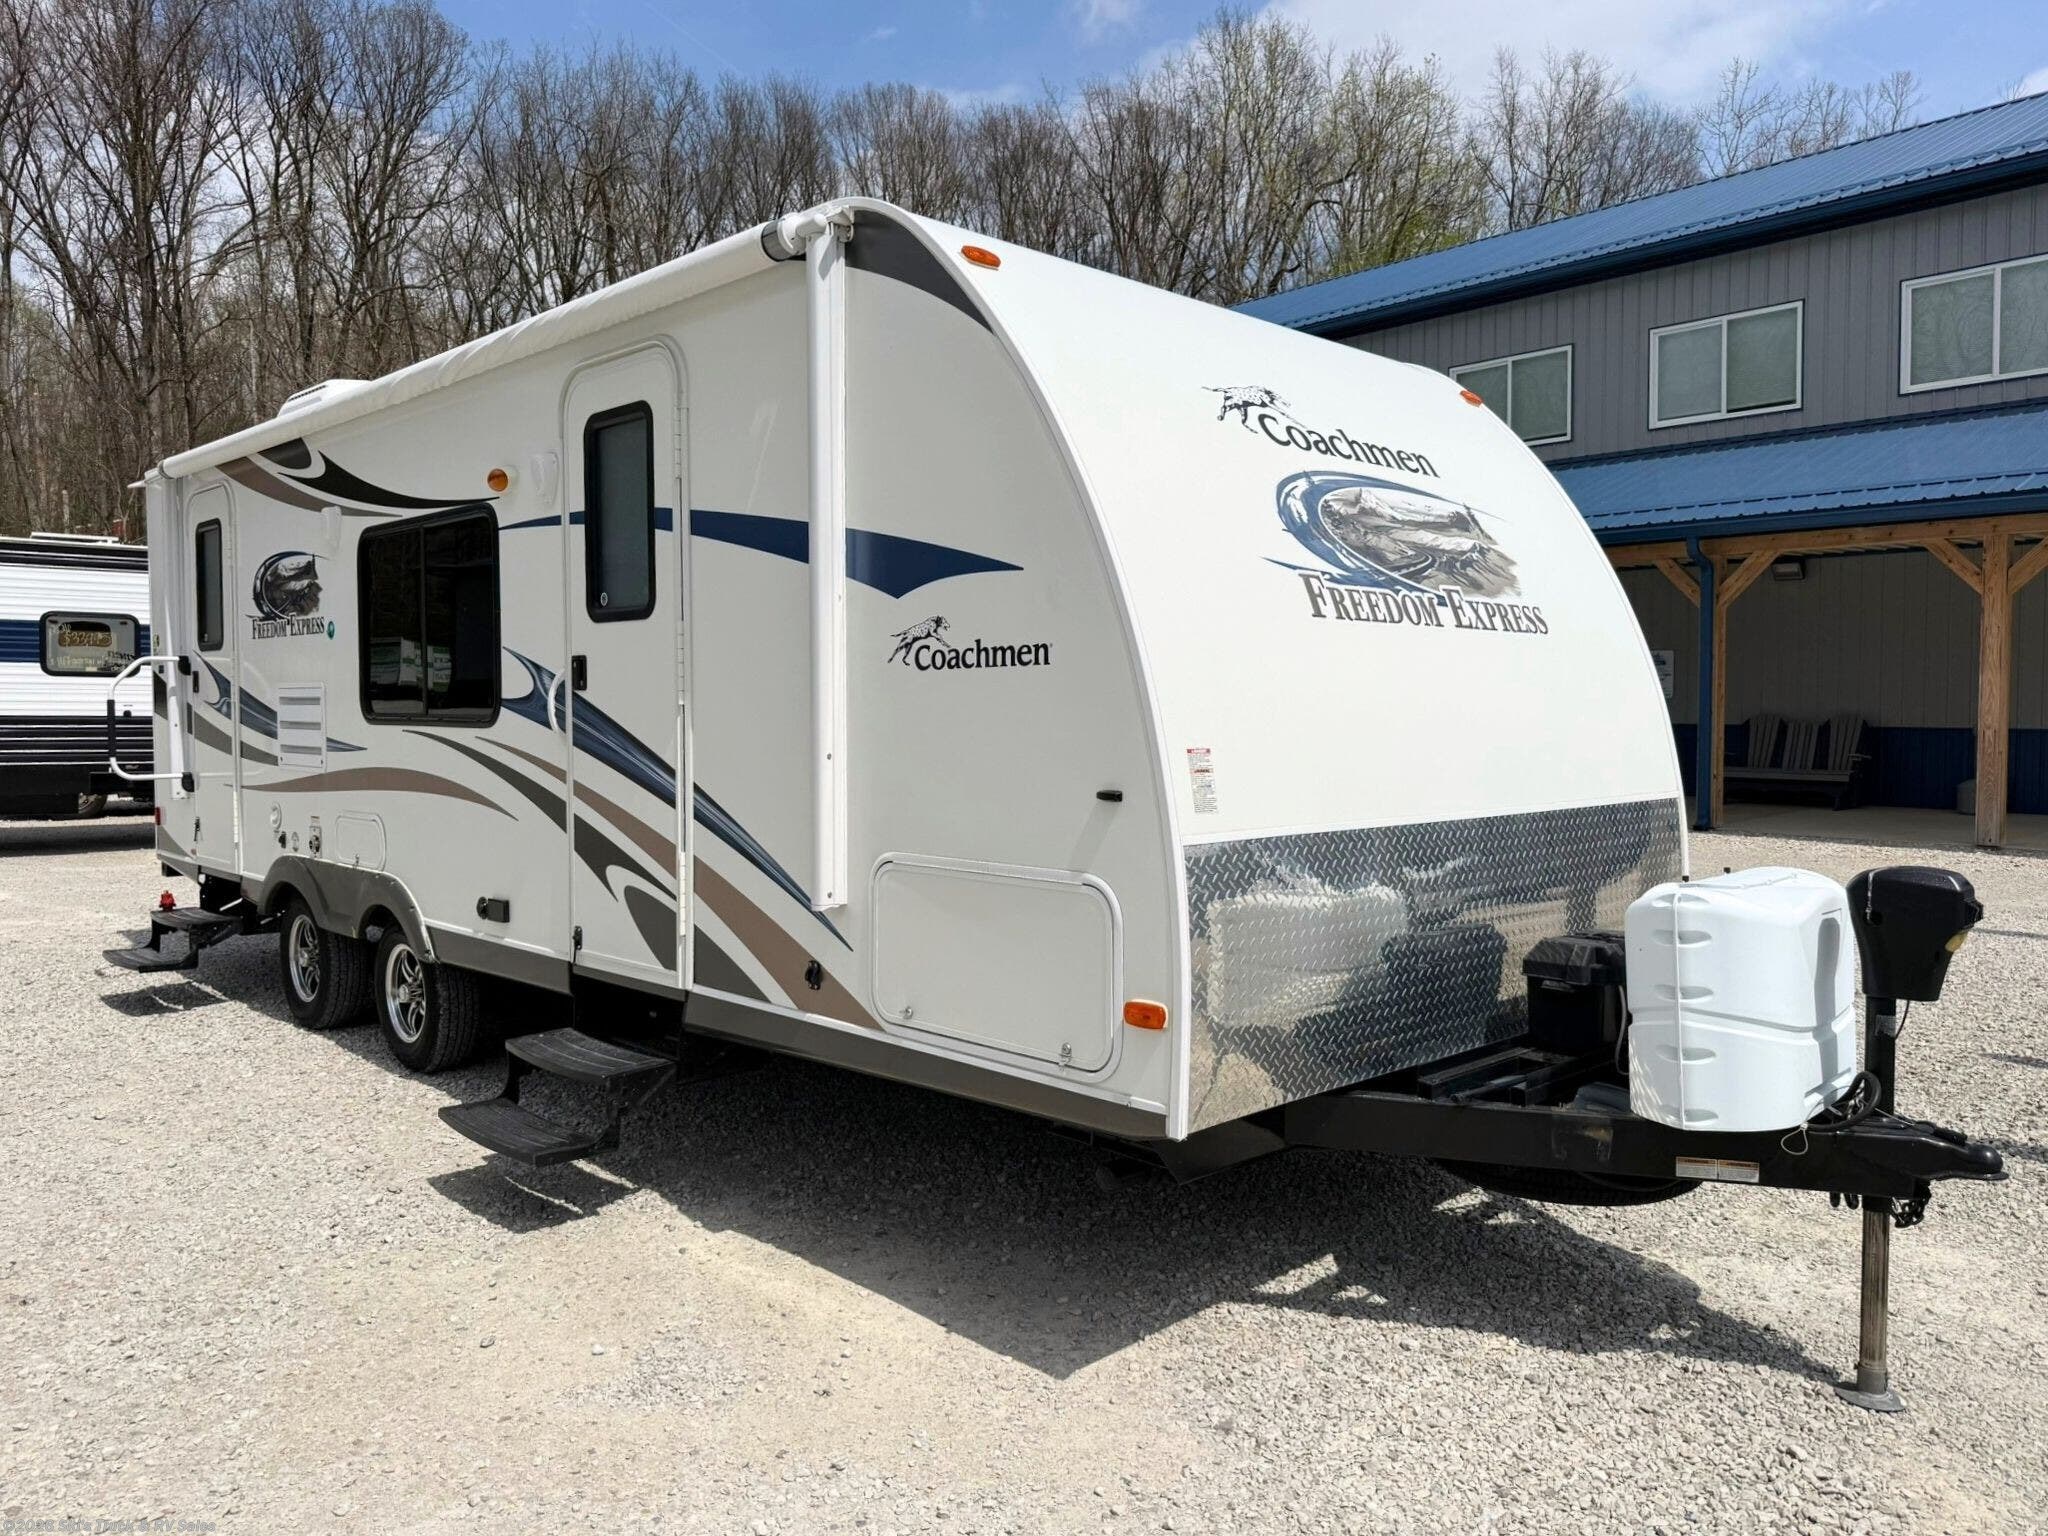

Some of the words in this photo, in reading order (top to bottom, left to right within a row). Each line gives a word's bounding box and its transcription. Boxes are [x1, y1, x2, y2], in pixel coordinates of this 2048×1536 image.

[1258, 414, 1440, 478] Coachmen
[252, 618, 287, 639] FREEDOM
[290, 614, 325, 636] EXPRESS
[1299, 573, 1444, 628] FREEDOM
[1442, 587, 1549, 634] EXPRESS
[914, 639, 1051, 671] Coachmen
